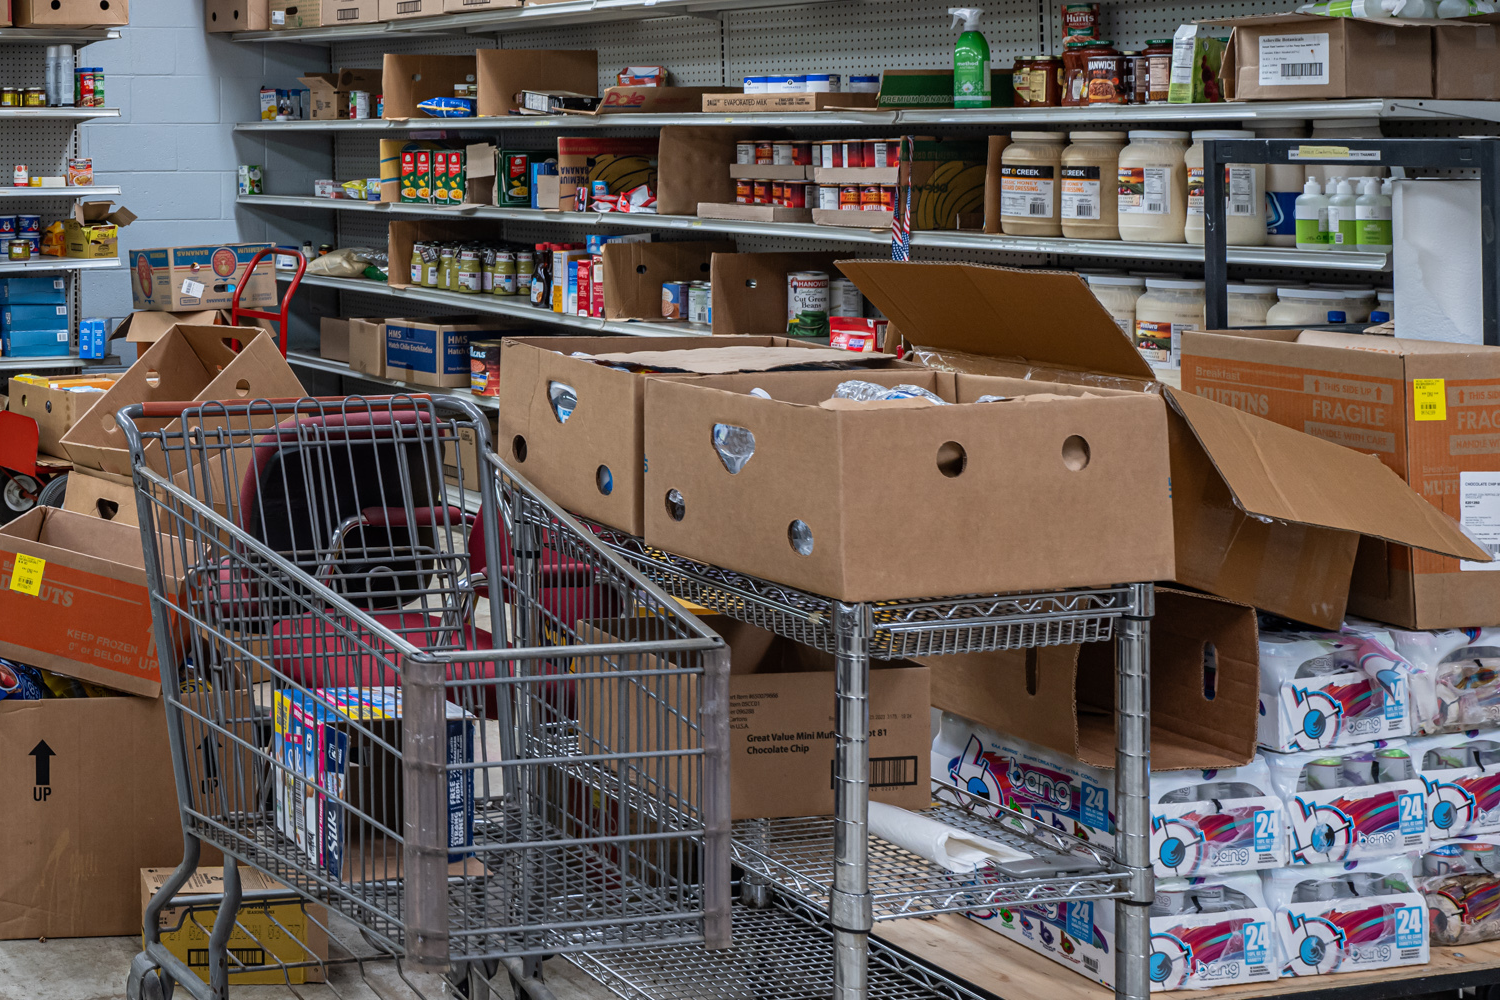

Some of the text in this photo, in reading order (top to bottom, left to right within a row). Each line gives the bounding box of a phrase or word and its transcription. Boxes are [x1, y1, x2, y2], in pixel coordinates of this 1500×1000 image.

[603, 92, 647, 106] Dole
[756, 98, 768, 106] MILK
[388, 330, 401, 338] HMS
[448, 336, 468, 344] HMS
[1195, 366, 1240, 381] Breakfast
[1324, 382, 1371, 396] THIS SIDE UP
[1312, 399, 1385, 426] FRAGILE
[66, 628, 138, 654] KEEP FROZEN
[94, 649, 132, 665] BELOW
[138, 657, 158, 671] UP
[747, 732, 815, 743] Great Value Mini
[747, 744, 810, 755] Chocolate Chip
[32, 786, 52, 802] UP
[1086, 787, 1104, 811] 24
[1401, 795, 1423, 820] 24
[1256, 812, 1279, 839] 24
[1398, 909, 1422, 935] 24
[1245, 924, 1269, 950] 24
